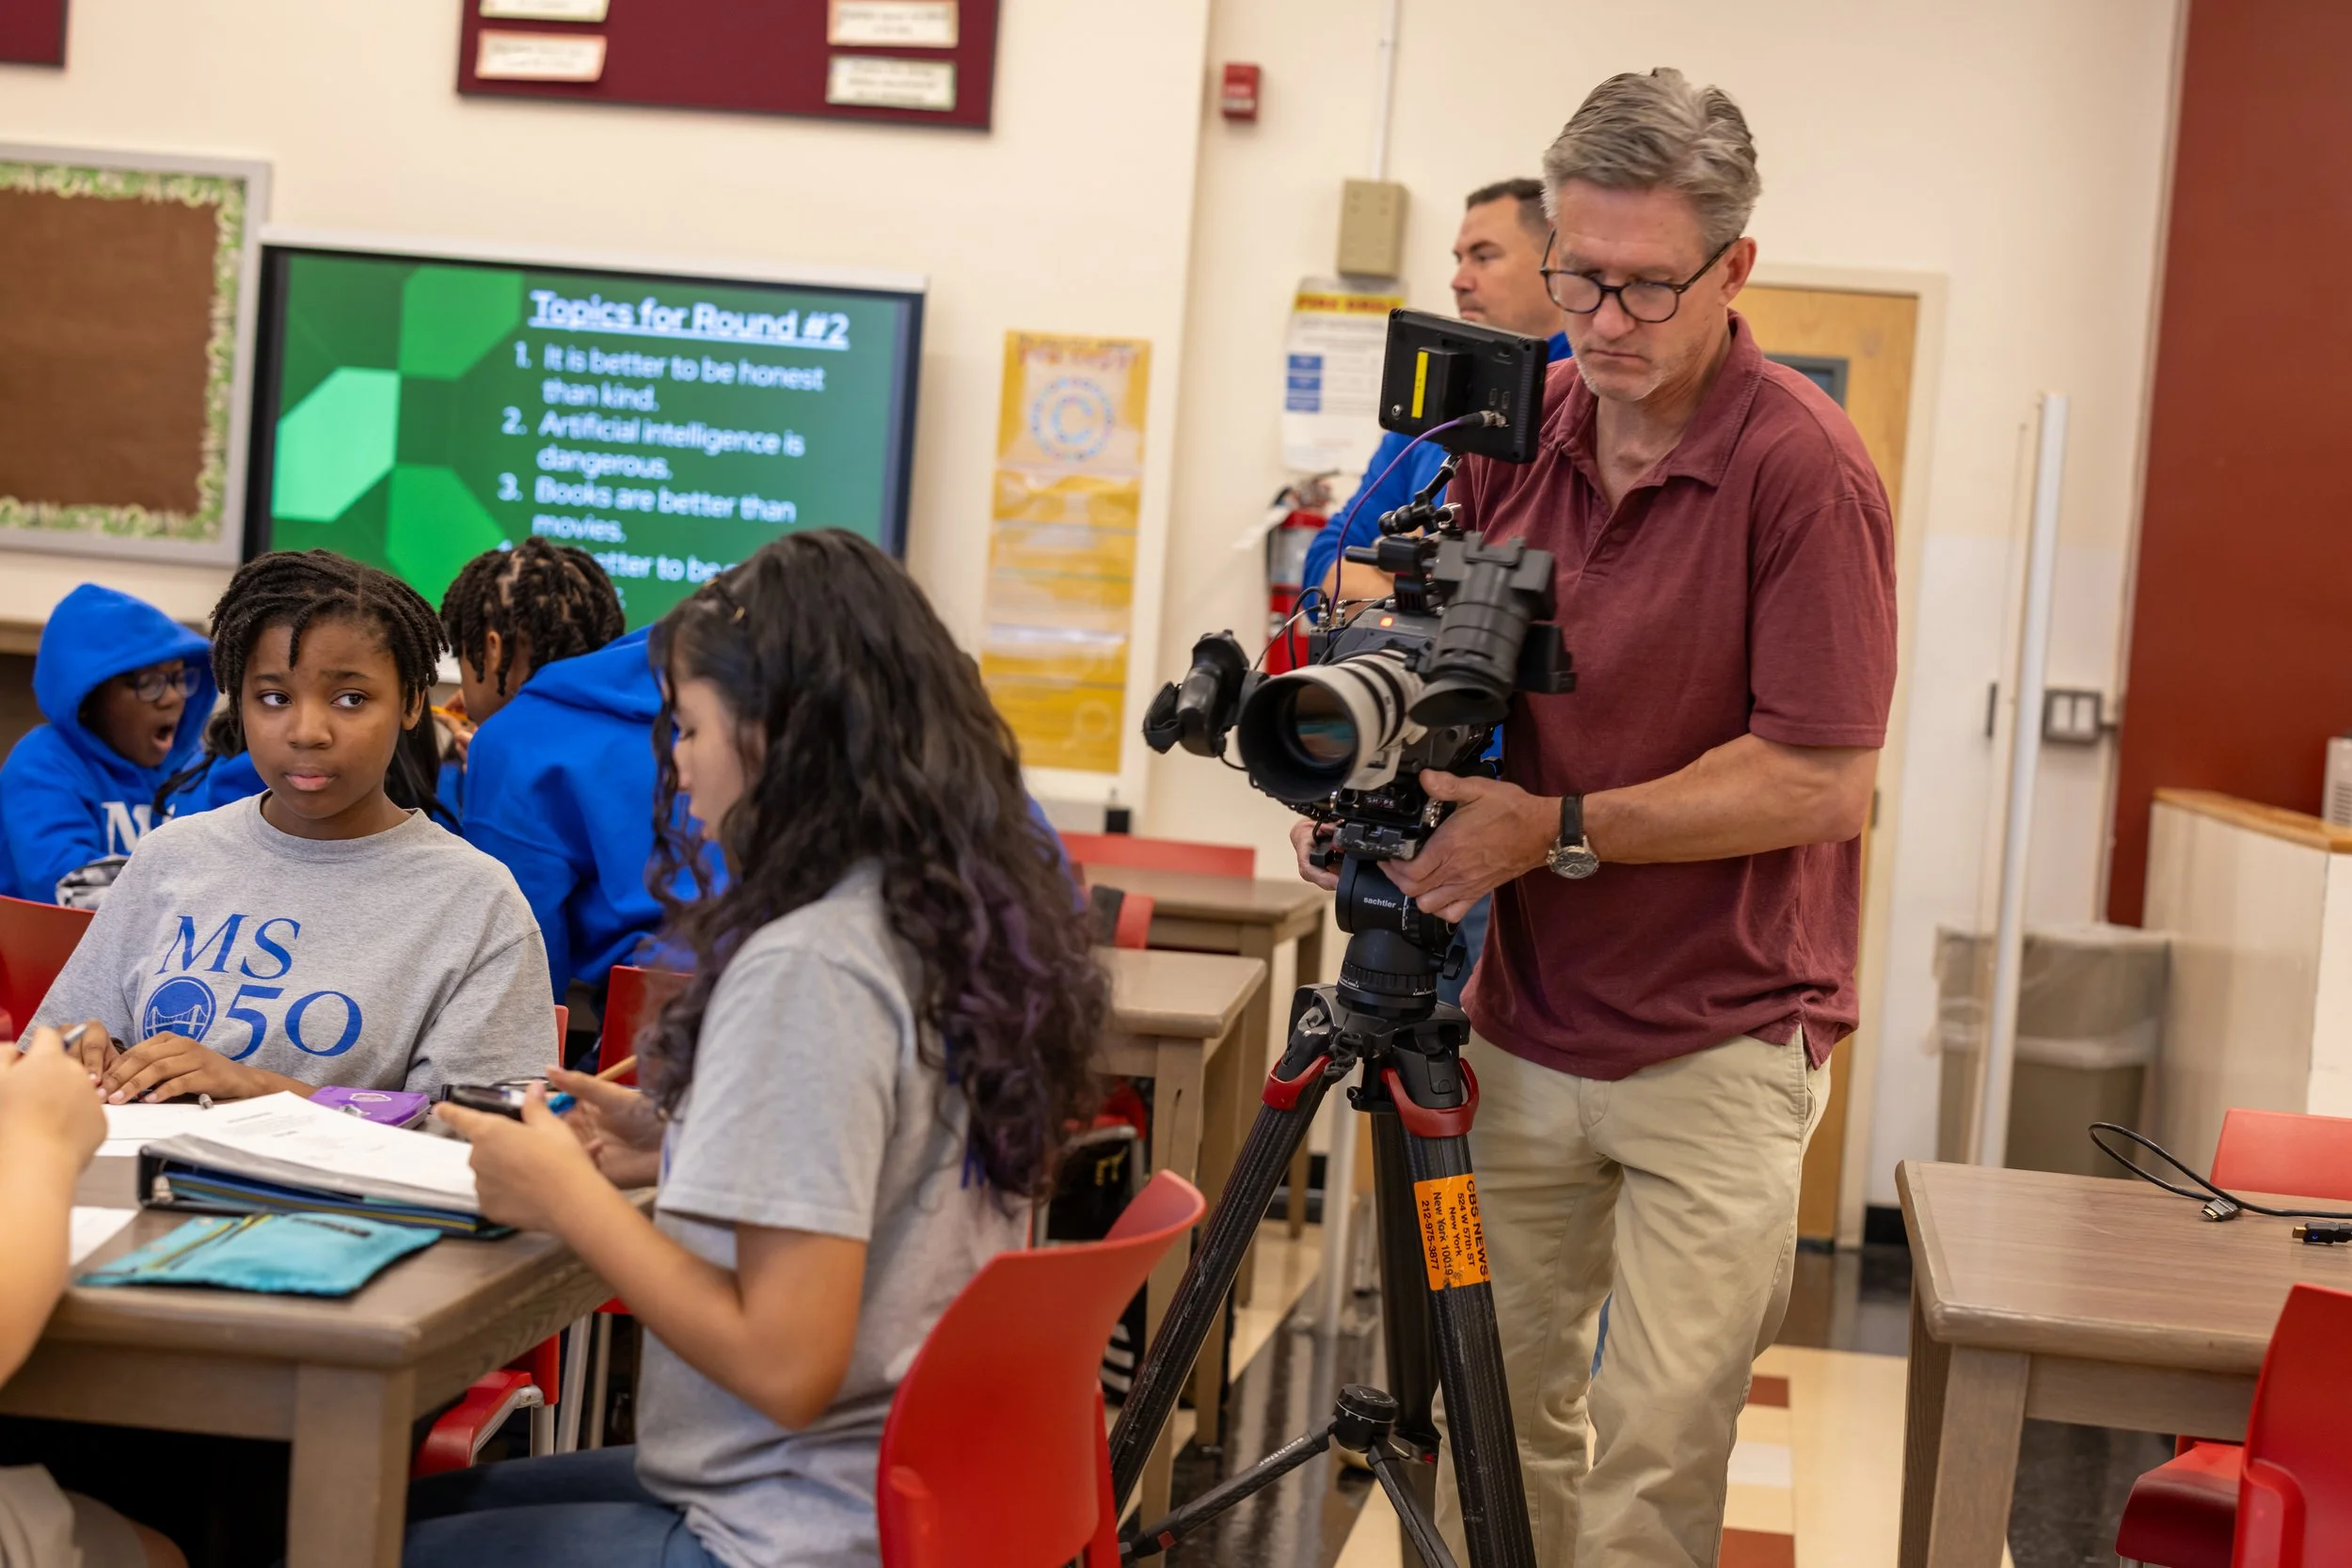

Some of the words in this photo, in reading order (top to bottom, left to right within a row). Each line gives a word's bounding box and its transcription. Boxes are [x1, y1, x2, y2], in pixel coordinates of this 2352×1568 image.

[530, 290, 636, 331] Topics
[639, 296, 689, 330] for
[691, 302, 798, 340] Round
[802, 310, 850, 348] #2
[515, 341, 532, 369] 1.
[544, 343, 564, 372] It
[565, 344, 587, 373] is
[588, 346, 668, 379] better
[671, 355, 699, 382] to
[701, 355, 736, 386] be
[738, 357, 827, 391] honest
[542, 377, 599, 405] than
[600, 381, 660, 413] kind.
[501, 406, 528, 435] 2.
[537, 410, 641, 444] Artificial
[642, 418, 781, 456] intelligence
[783, 429, 805, 457] is
[535, 443, 674, 481] dangerous.
[497, 472, 523, 501] 3.
[534, 475, 613, 510] Books
[613, 487, 657, 513] are
[658, 484, 739, 518] better
[739, 492, 797, 524] than
[532, 514, 627, 544] movies.
[594, 551, 653, 579] etter
[657, 553, 684, 582] to
[686, 554, 721, 583] be
[1363, 896, 1397, 910] sachtler
[154, 913, 301, 980] MS
[1433, 1192, 1442, 1215] New
[1457, 1193, 1467, 1212] 524
[1467, 1180, 1480, 1218] CBS
[1422, 1200, 1439, 1271] 212-975-3877
[1437, 1218, 1446, 1243] York
[1461, 1214, 1469, 1225] W
[1453, 1232, 1462, 1257] York
[1463, 1227, 1471, 1250] 57th
[1472, 1223, 1488, 1276] NEWS
[1441, 1245, 1454, 1276] 10019
[1468, 1253, 1475, 1267] ST
